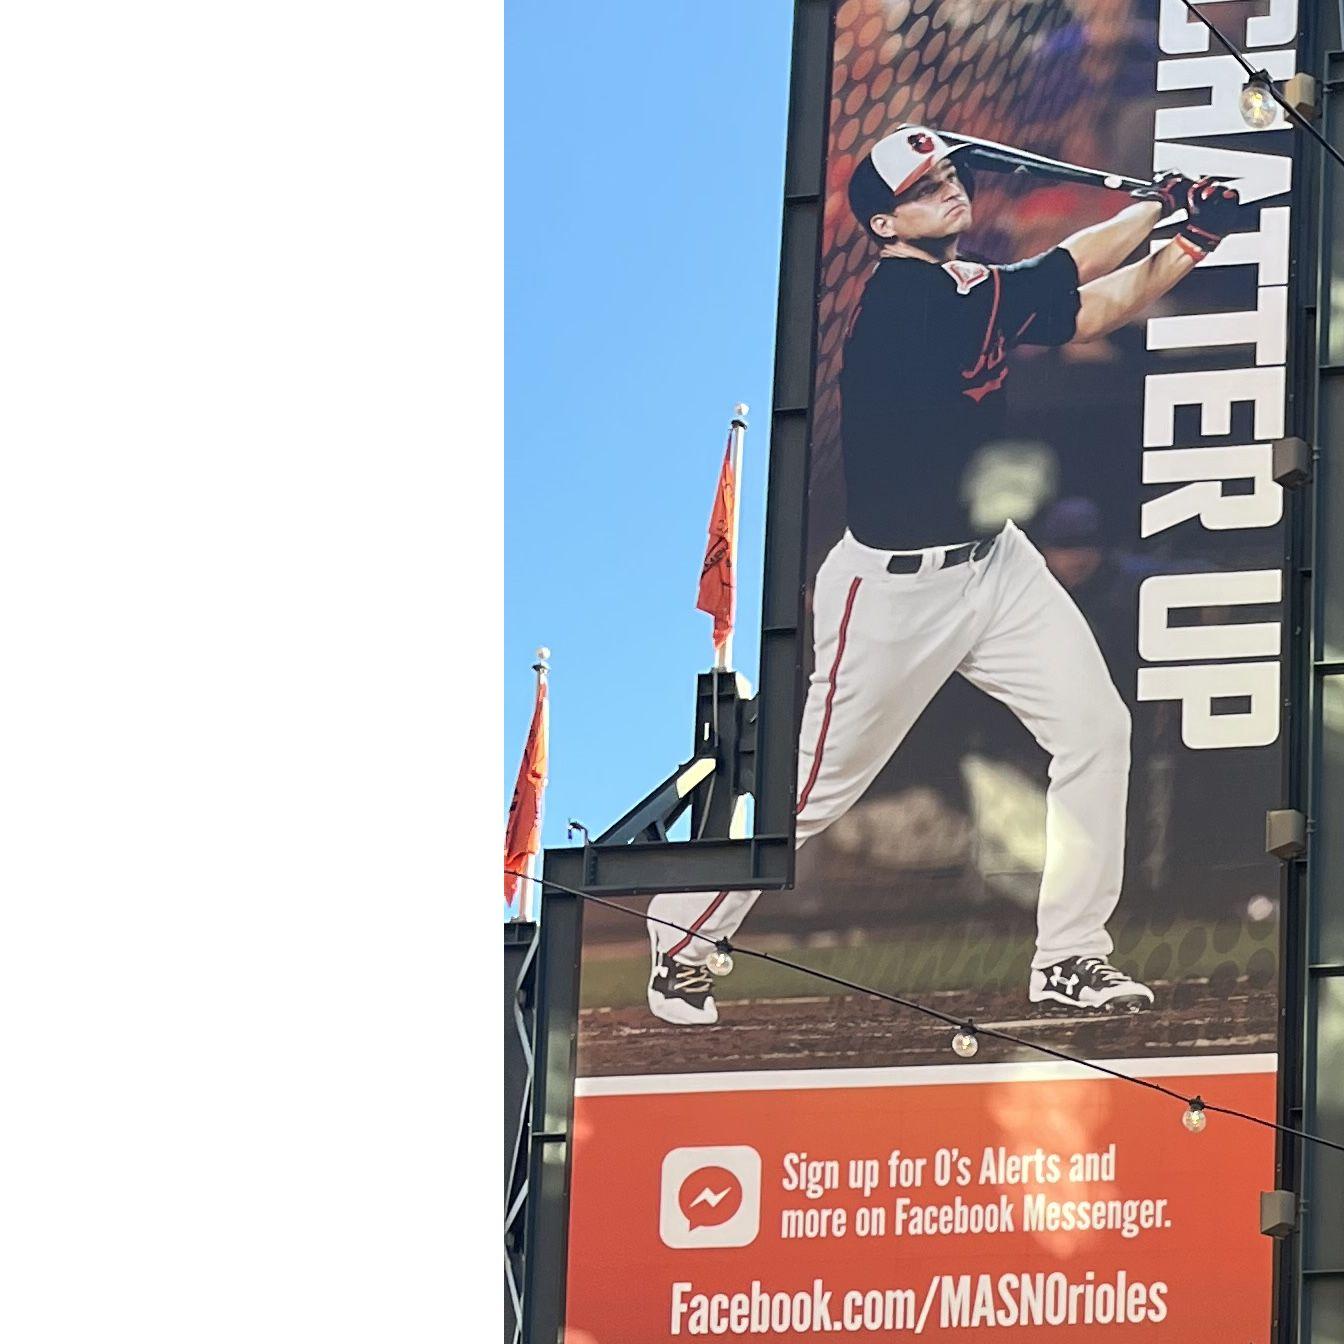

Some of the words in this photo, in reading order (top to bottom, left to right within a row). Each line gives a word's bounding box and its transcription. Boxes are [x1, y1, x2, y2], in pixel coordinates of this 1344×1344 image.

[1136, 568, 1282, 750] UP
[782, 1152, 839, 1199] Sign
[849, 1158, 880, 1196] up
[888, 1150, 927, 1188] for
[979, 1147, 1062, 1185] Alerts
[1069, 1144, 1116, 1183] and
[781, 1206, 847, 1239] more
[855, 1205, 886, 1237] on
[894, 1195, 1015, 1237] Facebook
[1022, 1193, 1172, 1239] Messenger.
[670, 1270, 1169, 1336] Facebook.com/MASNOrioles
